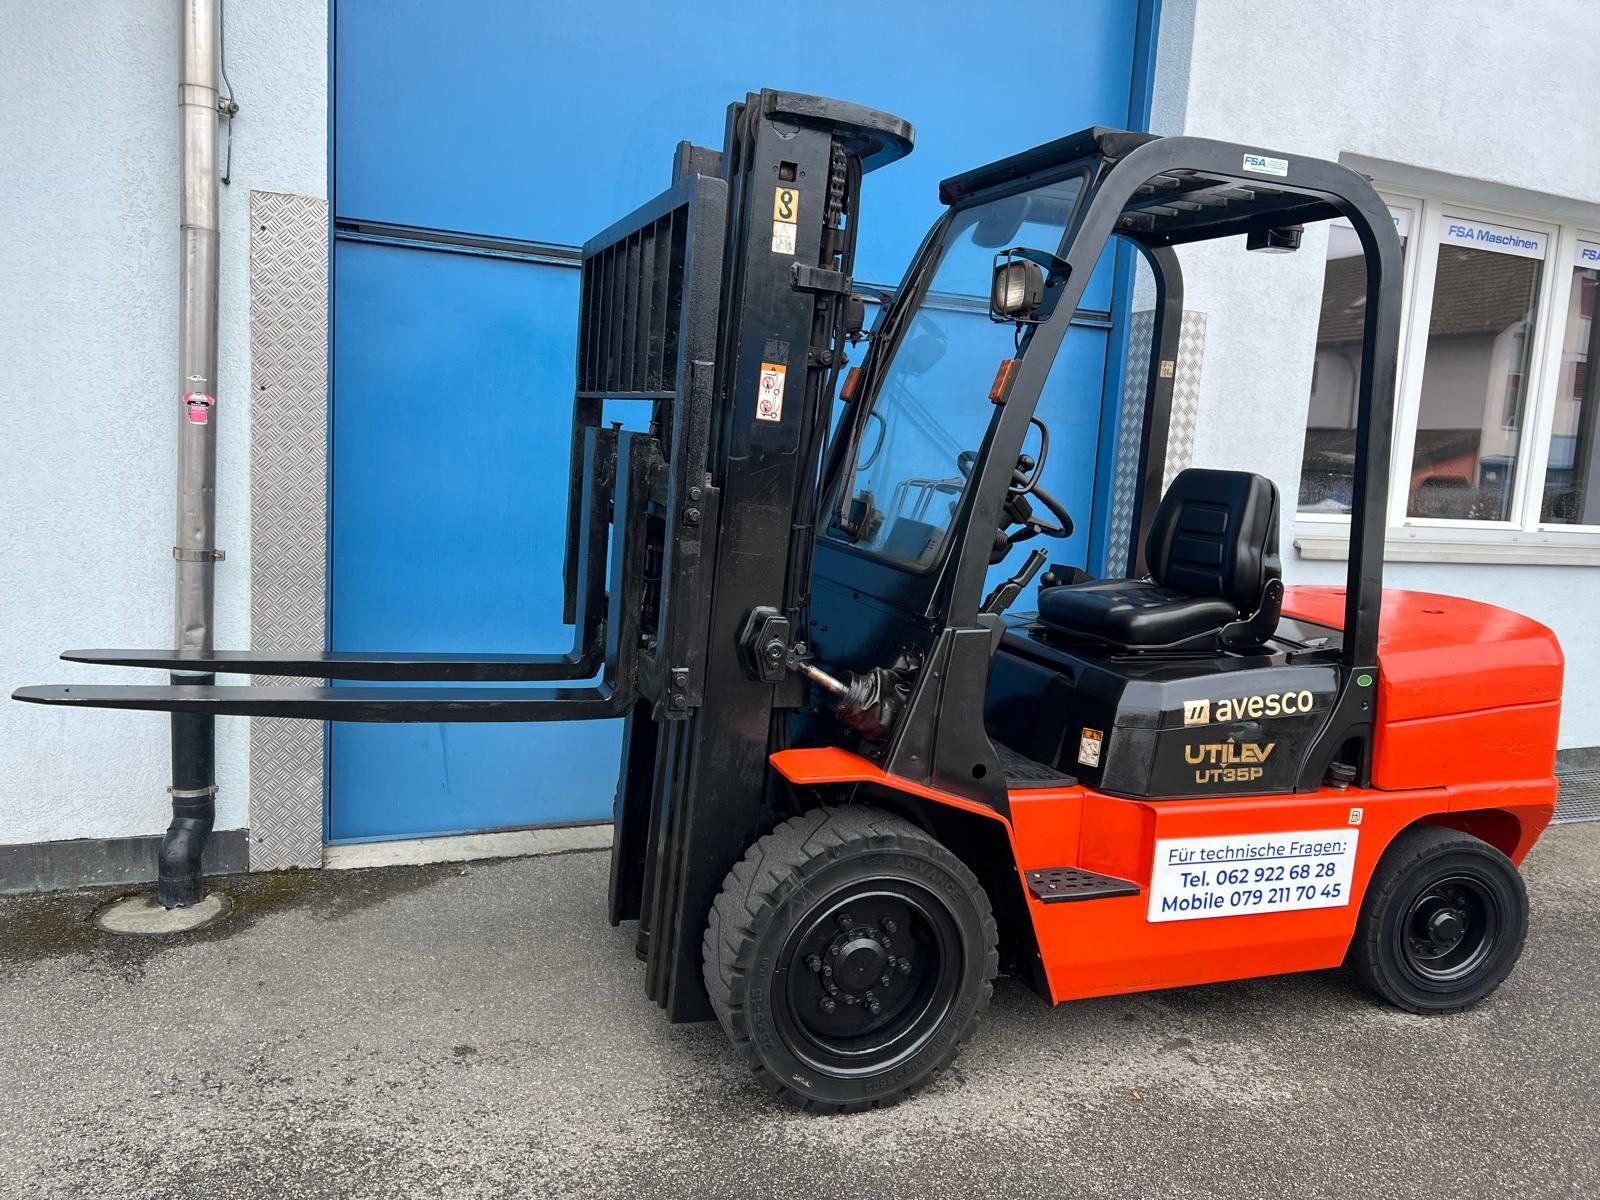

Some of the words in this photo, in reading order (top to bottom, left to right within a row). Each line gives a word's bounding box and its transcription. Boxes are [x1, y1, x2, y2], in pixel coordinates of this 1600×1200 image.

[1245, 156, 1266, 168] FSA
[1448, 224, 1474, 239] FSA
[1477, 229, 1538, 250] Maschinen
[1215, 690, 1313, 722] avesco
[1184, 740, 1275, 766] UTILEV
[1195, 767, 1264, 784] UT35P
[1168, 847, 1195, 863] Für
[1200, 843, 1286, 862] technische
[1290, 839, 1347, 858] Fragen:
[1181, 872, 1210, 888] Tel.
[1216, 869, 1248, 886] 062
[1254, 866, 1285, 884] 922
[1290, 864, 1311, 880] 68
[1316, 862, 1336, 878] 28
[1161, 892, 1225, 913] Mobile
[1230, 890, 1263, 907] 079
[1267, 887, 1291, 904] 211
[1295, 885, 1316, 901] 70
[1320, 882, 1342, 898] 45
